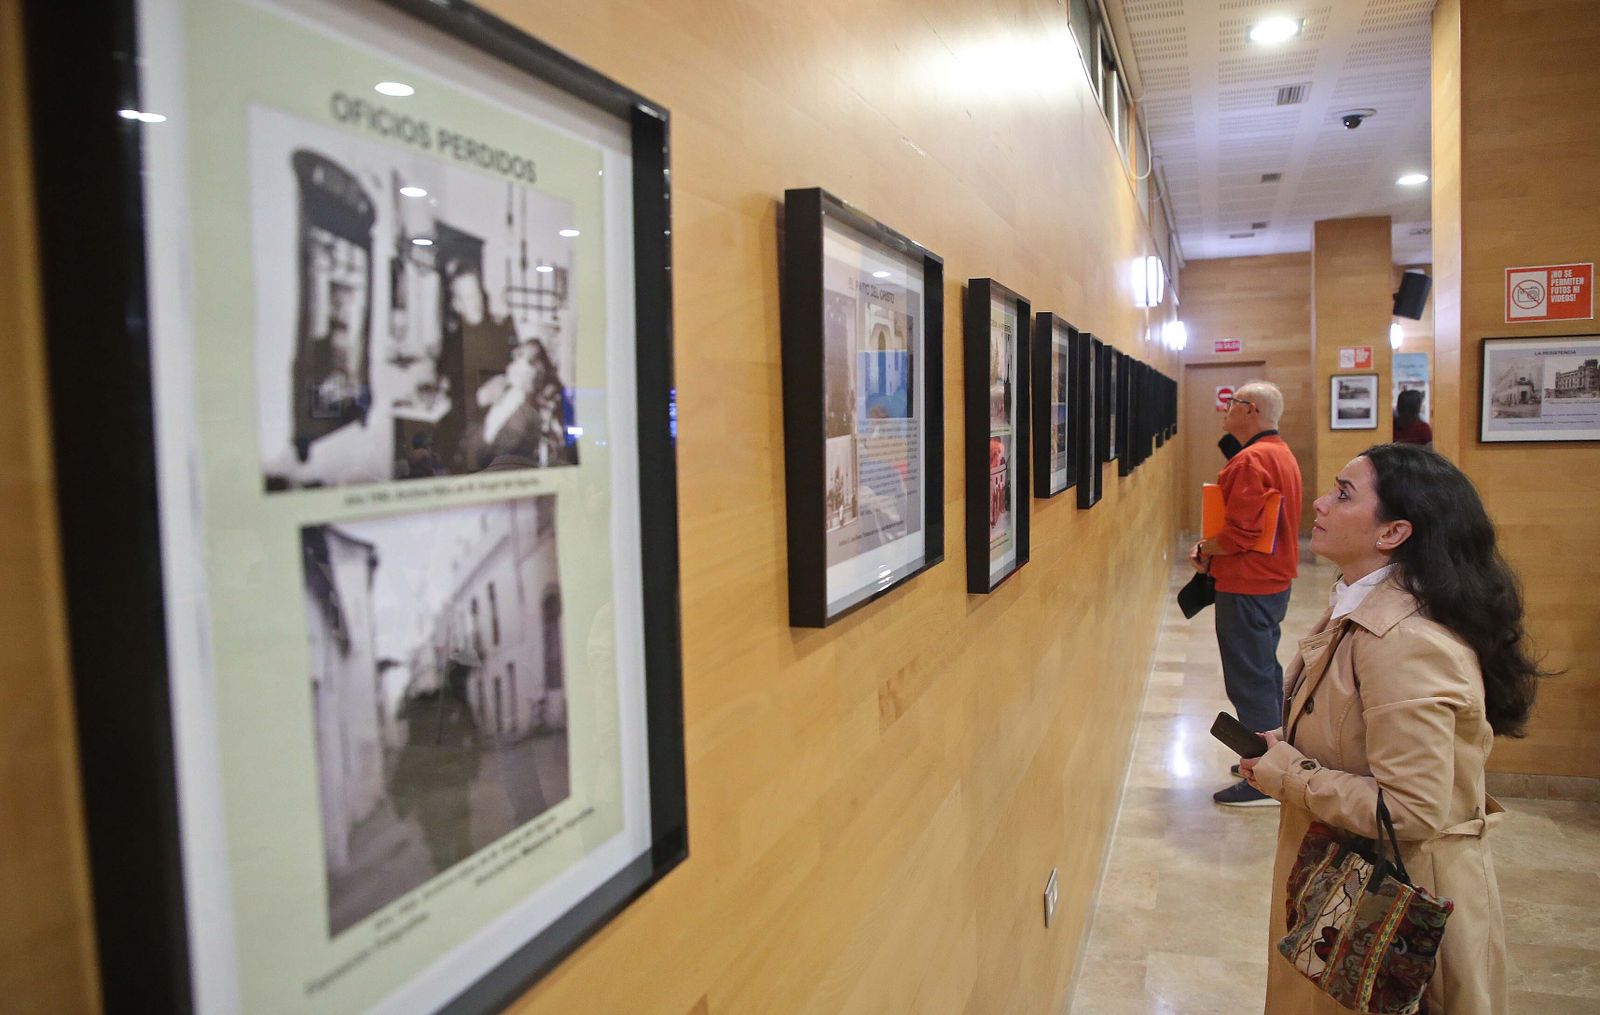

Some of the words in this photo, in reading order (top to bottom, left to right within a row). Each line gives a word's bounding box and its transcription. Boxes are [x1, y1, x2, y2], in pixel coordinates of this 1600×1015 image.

[330, 90, 432, 149] OFICIOS
[437, 127, 538, 184] PERDIDOS
[1564, 269, 1573, 277] SE
[1551, 277, 1584, 286] PERMITEN
[1551, 285, 1571, 294] FOTOS
[1573, 285, 1581, 293] NI
[880, 288, 895, 304] CRISTO
[1551, 294, 1576, 302] VIDEOS!
